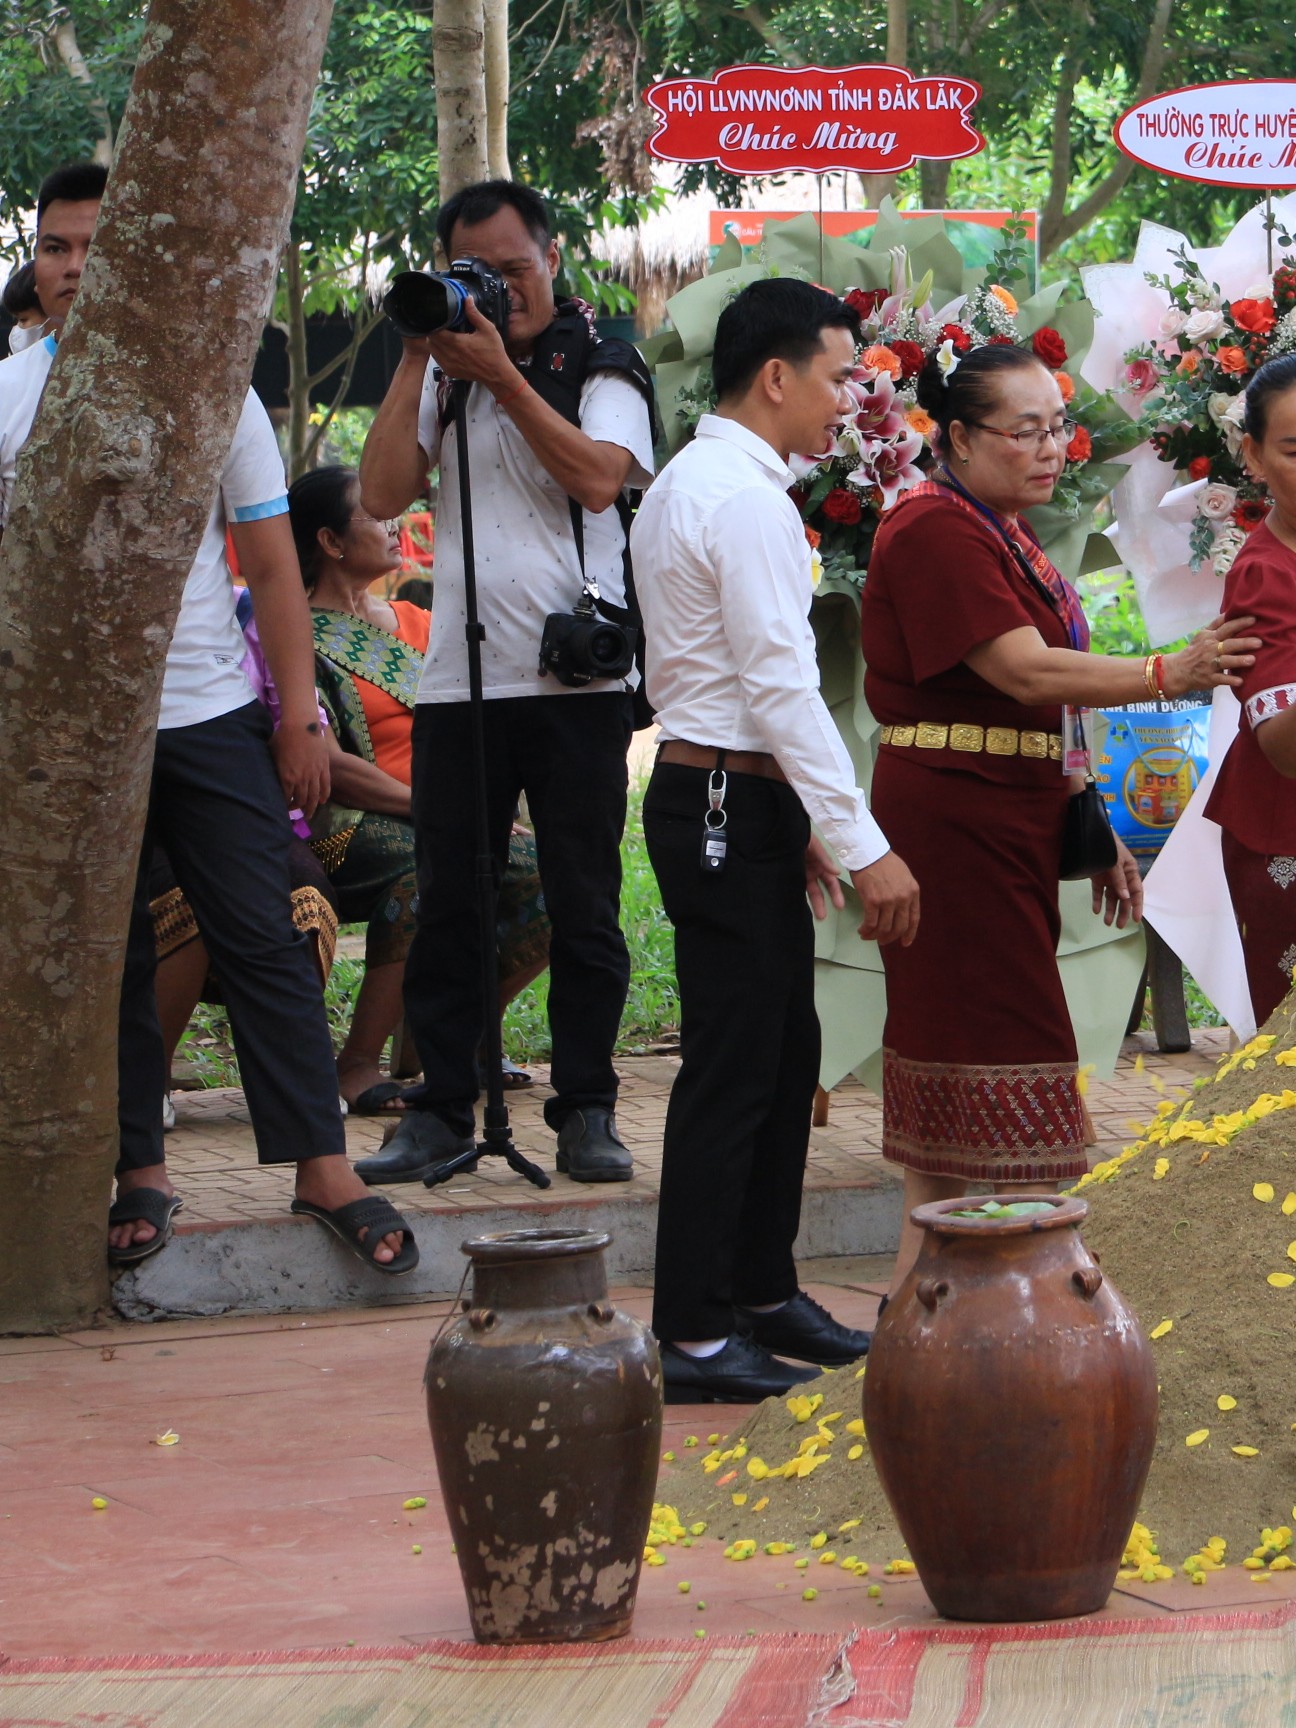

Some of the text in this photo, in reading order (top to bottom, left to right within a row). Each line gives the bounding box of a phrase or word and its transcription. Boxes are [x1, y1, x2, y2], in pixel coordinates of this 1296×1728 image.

[668, 79, 963, 117] HỘI LLVNVNƠNN TỈNH ĐĂK LĂK
[718, 121, 900, 156] Chúc Mừng
[1136, 106, 1204, 138] THƯỜNG
[1209, 108, 1250, 144] TRỰC
[1184, 141, 1265, 170] Chúc
